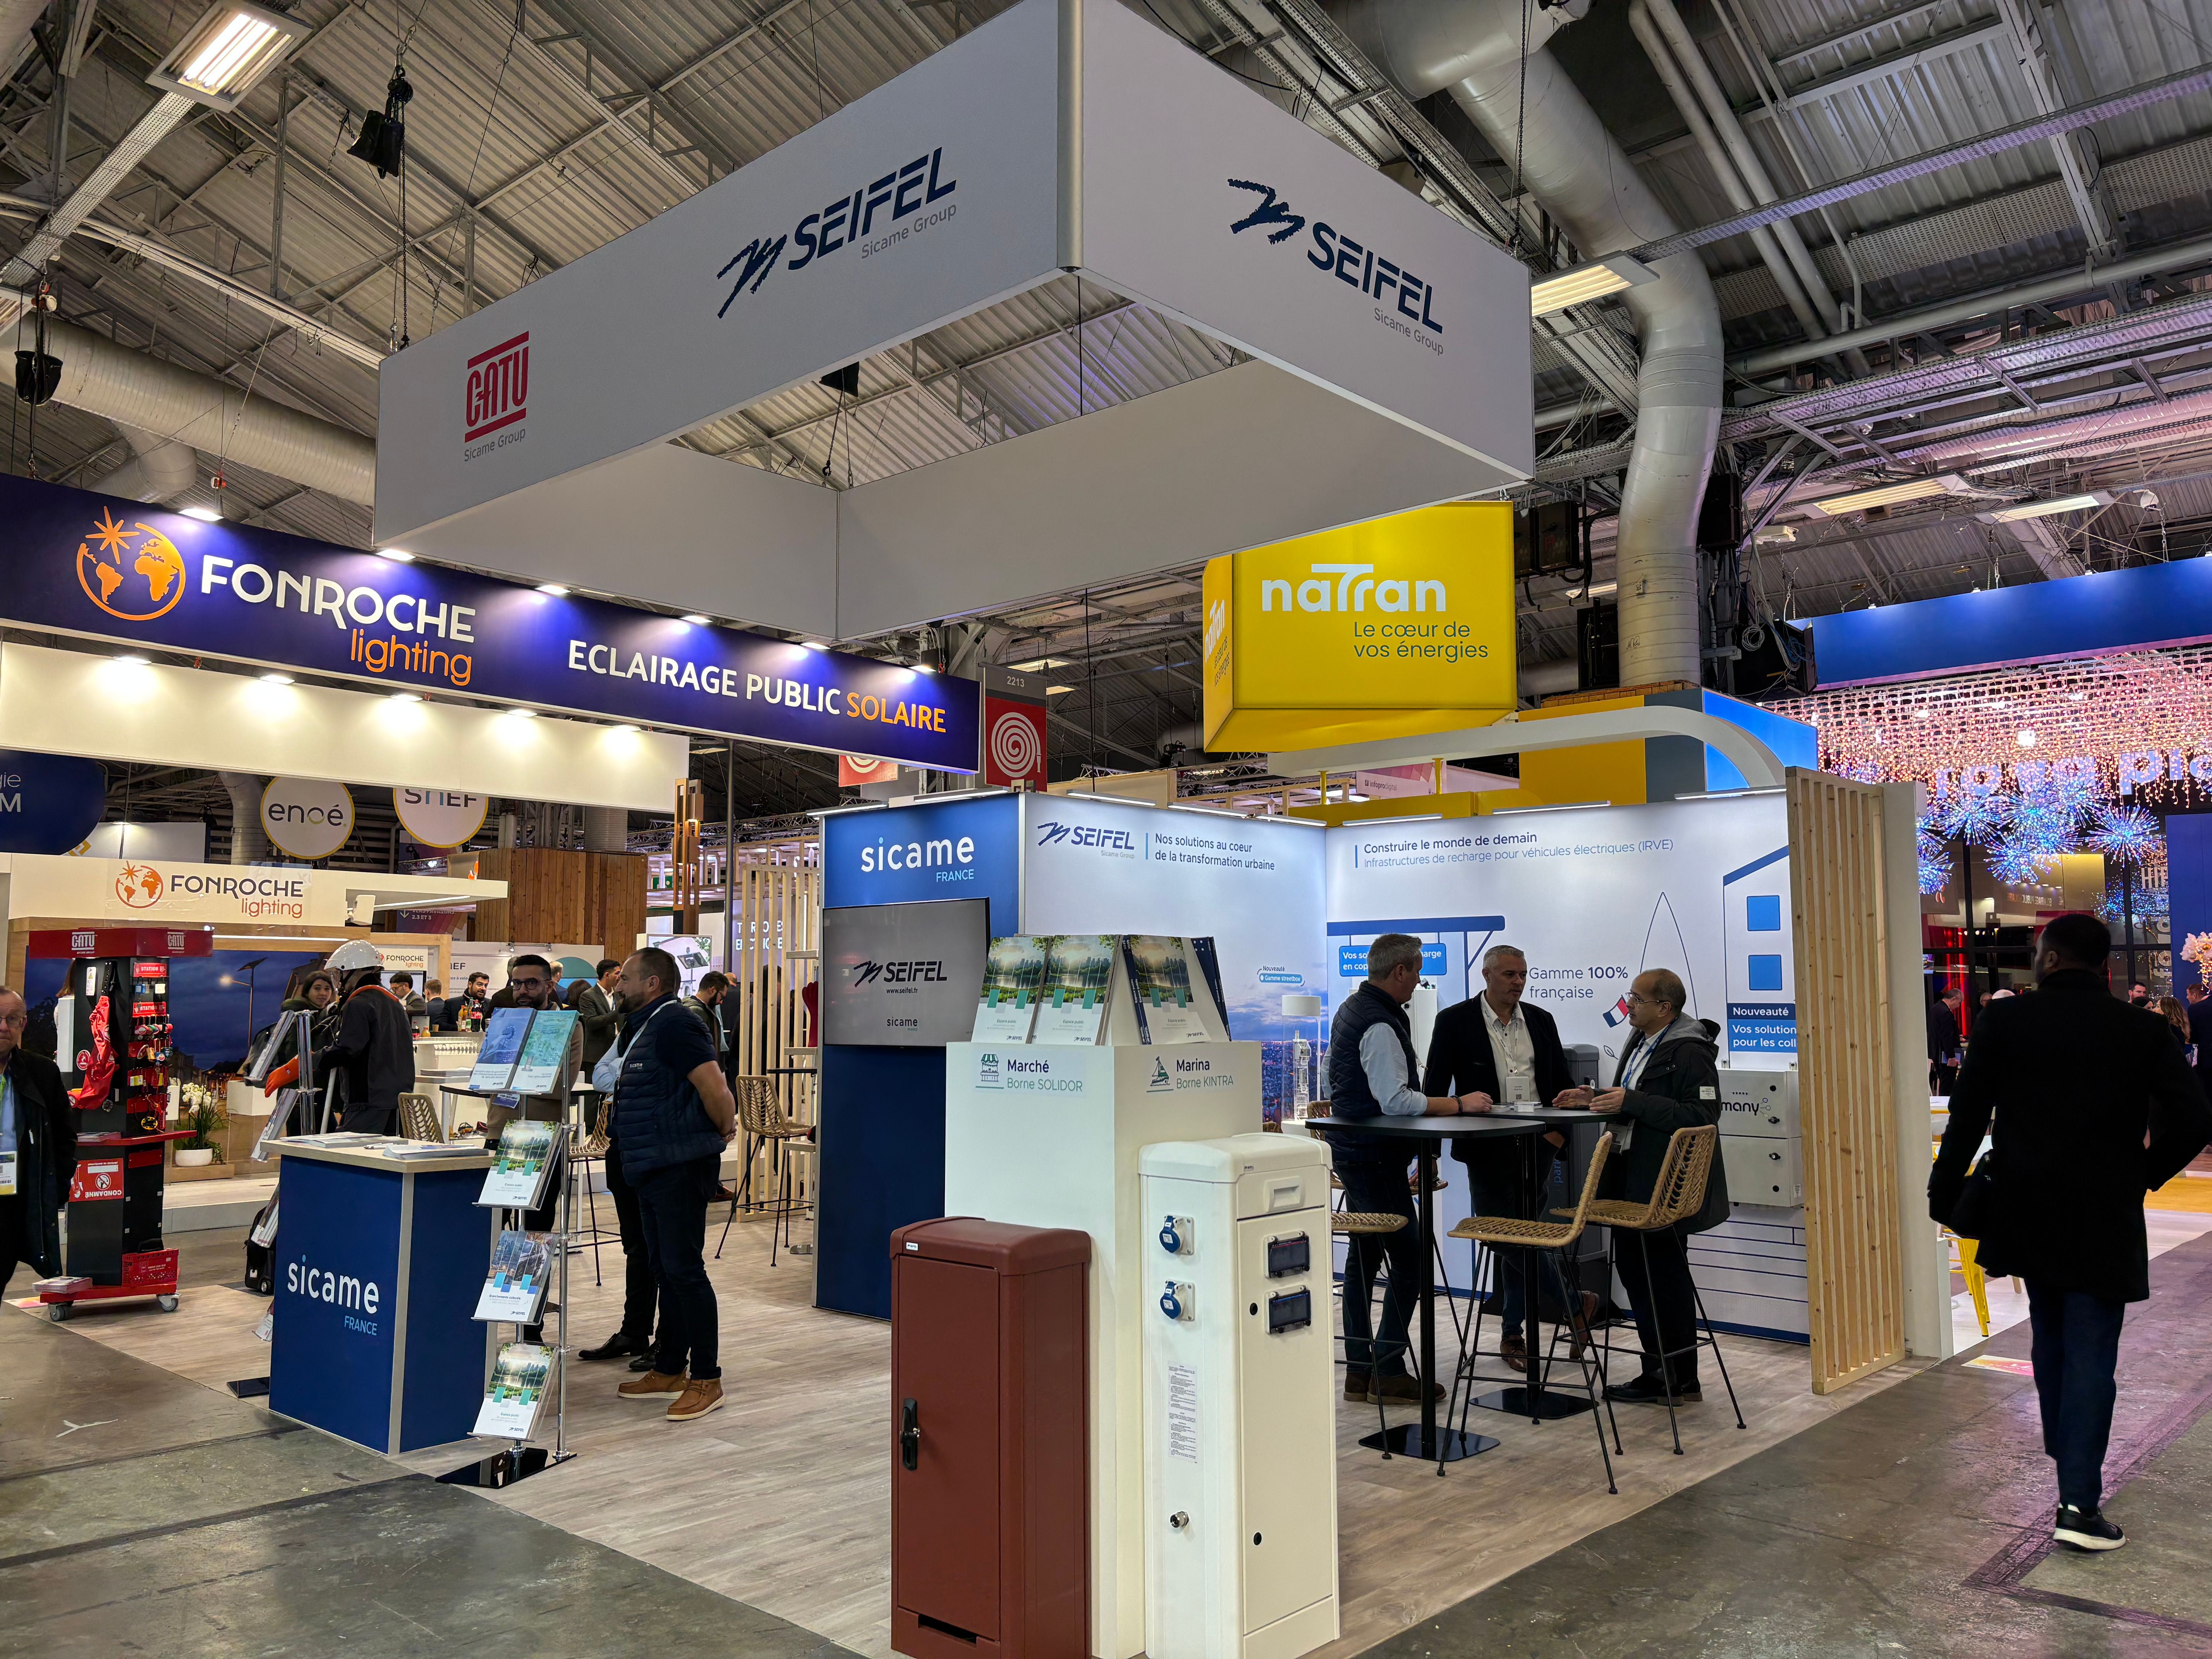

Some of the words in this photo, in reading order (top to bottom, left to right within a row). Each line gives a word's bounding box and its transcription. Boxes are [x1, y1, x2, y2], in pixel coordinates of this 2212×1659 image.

[788, 147, 957, 270] SEIFEL
[861, 228, 909, 259] Sicame
[913, 204, 957, 232] Group
[1307, 222, 1443, 335] SEIFEL
[1374, 307, 1411, 338] Sicame
[1414, 330, 1444, 356] Group
[466, 346, 529, 427] CATU
[464, 441, 495, 462] Sicame
[498, 428, 526, 447] Group
[201, 555, 476, 643] FONROCHE
[1354, 622, 1376, 637] Le
[1381, 623, 1437, 638] cœur
[1443, 621, 1470, 638] de
[351, 629, 472, 686] lighting
[1354, 645, 1390, 658] vos
[1397, 641, 1489, 663] énergies
[568, 640, 737, 699] ECLAIRAGE
[746, 673, 840, 715] PUBLIC
[847, 692, 946, 733] SOLAIRE
[1007, 676, 1025, 687] 2213
[1370, 780, 1397, 791] infoprodigital
[1071, 826, 1135, 850] SEIFEL
[1155, 833, 1173, 845] Nos
[1175, 836, 1214, 849] solutions
[1216, 842, 1227, 850] au
[1229, 843, 1252, 853] coeur
[1364, 840, 1417, 854] Construire
[1421, 839, 1430, 850] le
[1433, 836, 1472, 848] monde
[1475, 835, 1489, 846] de
[1493, 832, 1537, 845] demain
[860, 837, 974, 872] sicame
[1155, 850, 1167, 860] de
[1169, 851, 1176, 862] la
[1179, 854, 1242, 868] transformation
[1245, 859, 1275, 871] urbaine
[1364, 855, 1429, 868] Infrastructures
[1432, 854, 1445, 863] de
[1448, 851, 1492, 862] recharge
[1494, 850, 1519, 862] pour
[1522, 846, 1571, 858] véhicules
[1573, 843, 1635, 855] électriques
[1638, 839, 1673, 853] (IRVE)
[936, 869, 974, 883] FRANCE
[171, 875, 303, 898] FONROCHE
[242, 898, 303, 918] lighting
[72, 934, 95, 947] CATU
[168, 935, 184, 946] CATU
[884, 961, 947, 982] SEIFEL
[1529, 967, 1583, 980] Gamme
[1588, 966, 1628, 979] 100%
[1530, 985, 1594, 1000] française
[1733, 1007, 1789, 1016] Nouveauté
[887, 1017, 917, 1027] sicame
[1732, 1025, 1752, 1034] Vos
[1755, 1025, 1797, 1034] solution
[1733, 1039, 1757, 1048] pour
[1760, 1038, 1775, 1047] les
[1007, 1059, 1049, 1073] Marché
[1176, 1058, 1210, 1072] Marina
[1007, 1078, 1035, 1090] Borne
[1038, 1079, 1083, 1092] SOLIDOR
[1176, 1079, 1201, 1089] Borne
[1204, 1075, 1234, 1087] KINTRA
[1721, 1101, 1759, 1116] many
[287, 1254, 380, 1314] sicame
[344, 1315, 378, 1336] FRANCE
